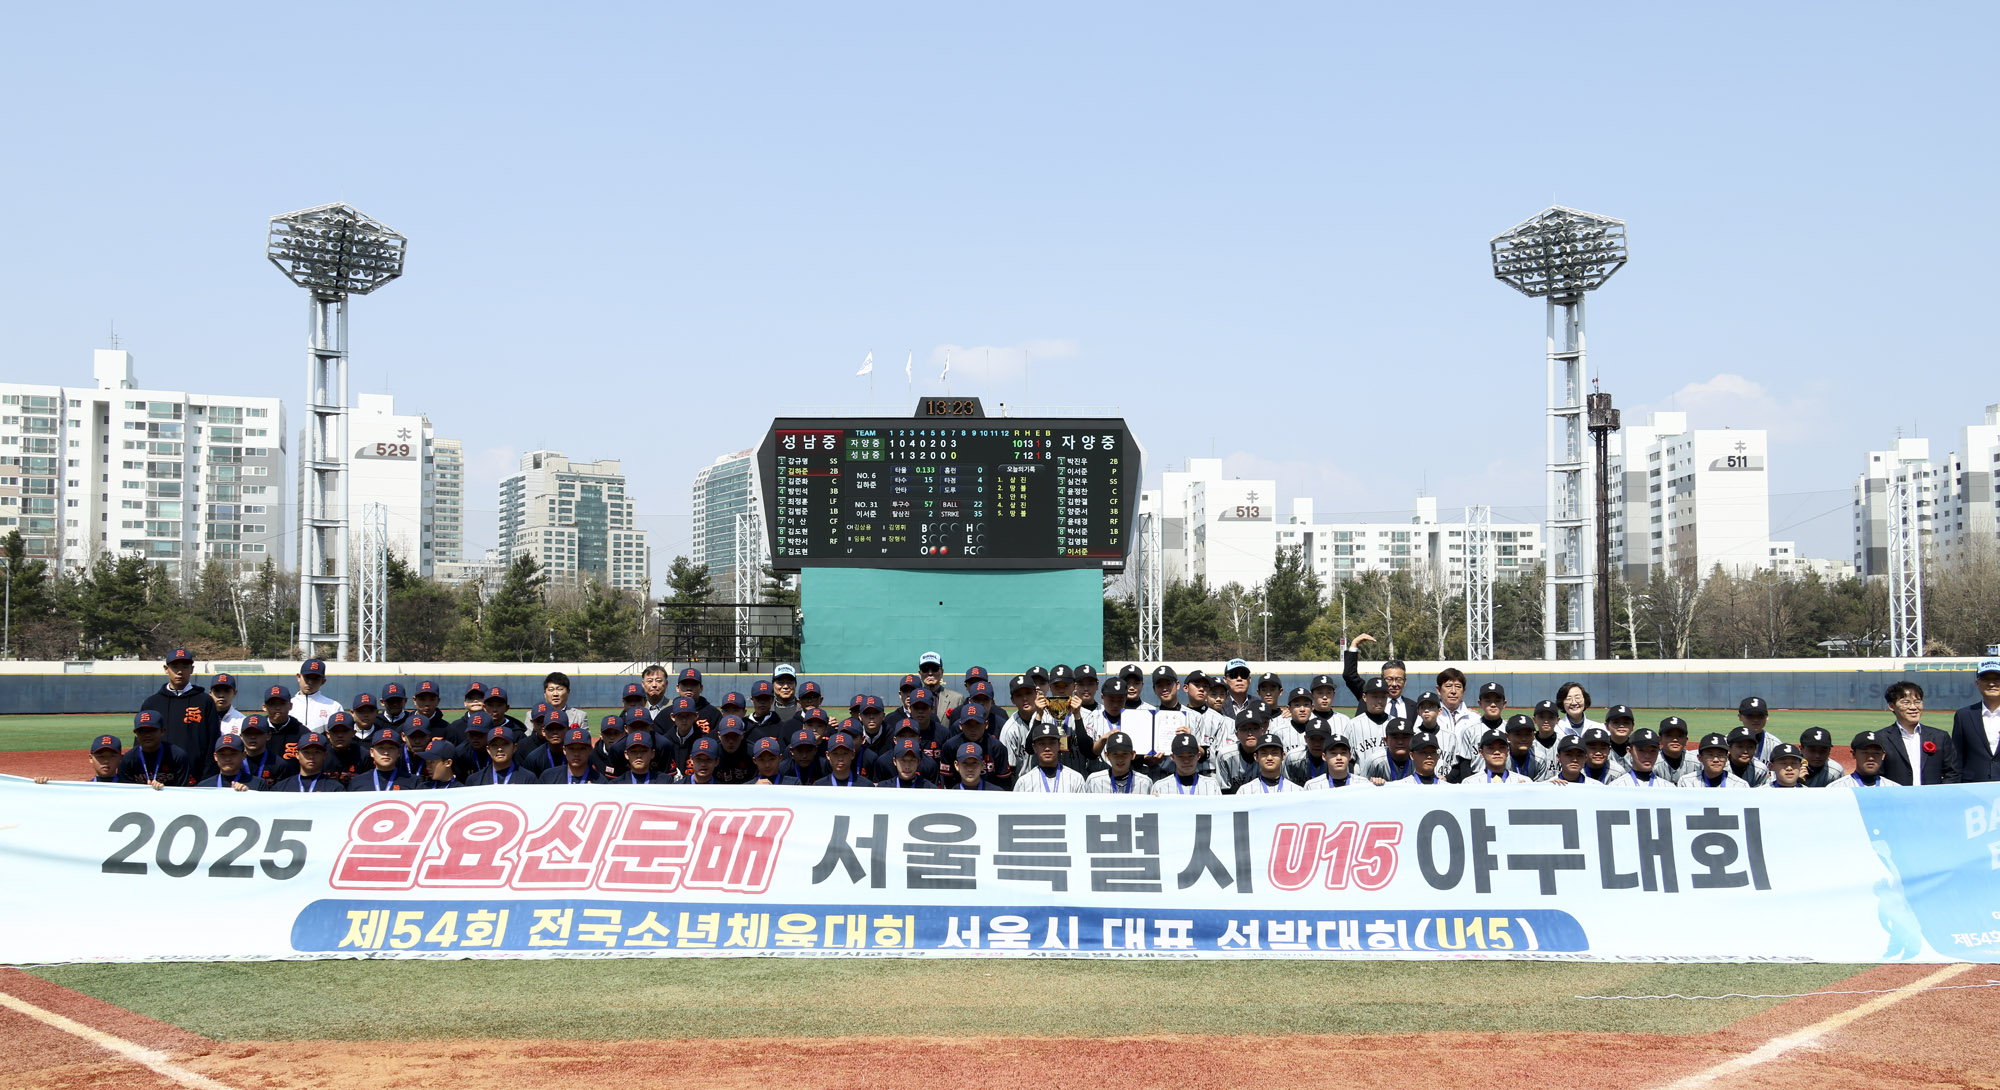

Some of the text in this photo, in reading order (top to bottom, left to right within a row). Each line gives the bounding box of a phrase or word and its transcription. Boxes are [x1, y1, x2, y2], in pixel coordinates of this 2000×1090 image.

[927, 400, 974, 415] 13:23
[783, 435, 835, 449] 성남중
[889, 439, 894, 448] 1
[899, 439, 906, 448] 0
[909, 439, 916, 448] 4
[919, 439, 926, 448] 0
[930, 439, 936, 448] 2
[940, 439, 947, 448] 0
[950, 439, 957, 448] 3
[1012, 439, 1023, 448] 10
[1023, 439, 1034, 448] 13
[1036, 439, 1040, 448] 1
[1045, 439, 1052, 448] 9
[1062, 435, 1115, 450] 자양중
[376, 442, 410, 458] 529
[889, 451, 894, 460] 1
[900, 451, 905, 460] 1
[909, 451, 916, 460] 3
[919, 451, 926, 460] 2
[930, 451, 936, 460] 0
[940, 451, 947, 460] 0
[950, 451, 957, 460] 0
[1014, 451, 1020, 460] 7
[1022, 451, 1034, 460] 12
[1036, 451, 1041, 460] 1
[1045, 451, 1052, 460] 8
[1067, 457, 1088, 466] 박진우
[1727, 455, 1748, 468] 511
[1066, 467, 1088, 476] 이서준
[1236, 505, 1260, 518] 513
[921, 523, 928, 533] B
[966, 523, 974, 533] H
[1067, 527, 1088, 536] 박서준
[921, 534, 928, 544] S
[966, 534, 973, 544] E
[920, 545, 929, 556] O
[964, 545, 977, 556] FC
[1067, 547, 1089, 556] 이서준
[102, 800, 1771, 895] 2025 일요신문배 서울특별시 U15 야구대회
[338, 909, 509, 949] 제54회
[528, 908, 915, 950] 전국소년체육대회
[937, 915, 1079, 950] 서울시
[1102, 917, 1194, 950] 대표
